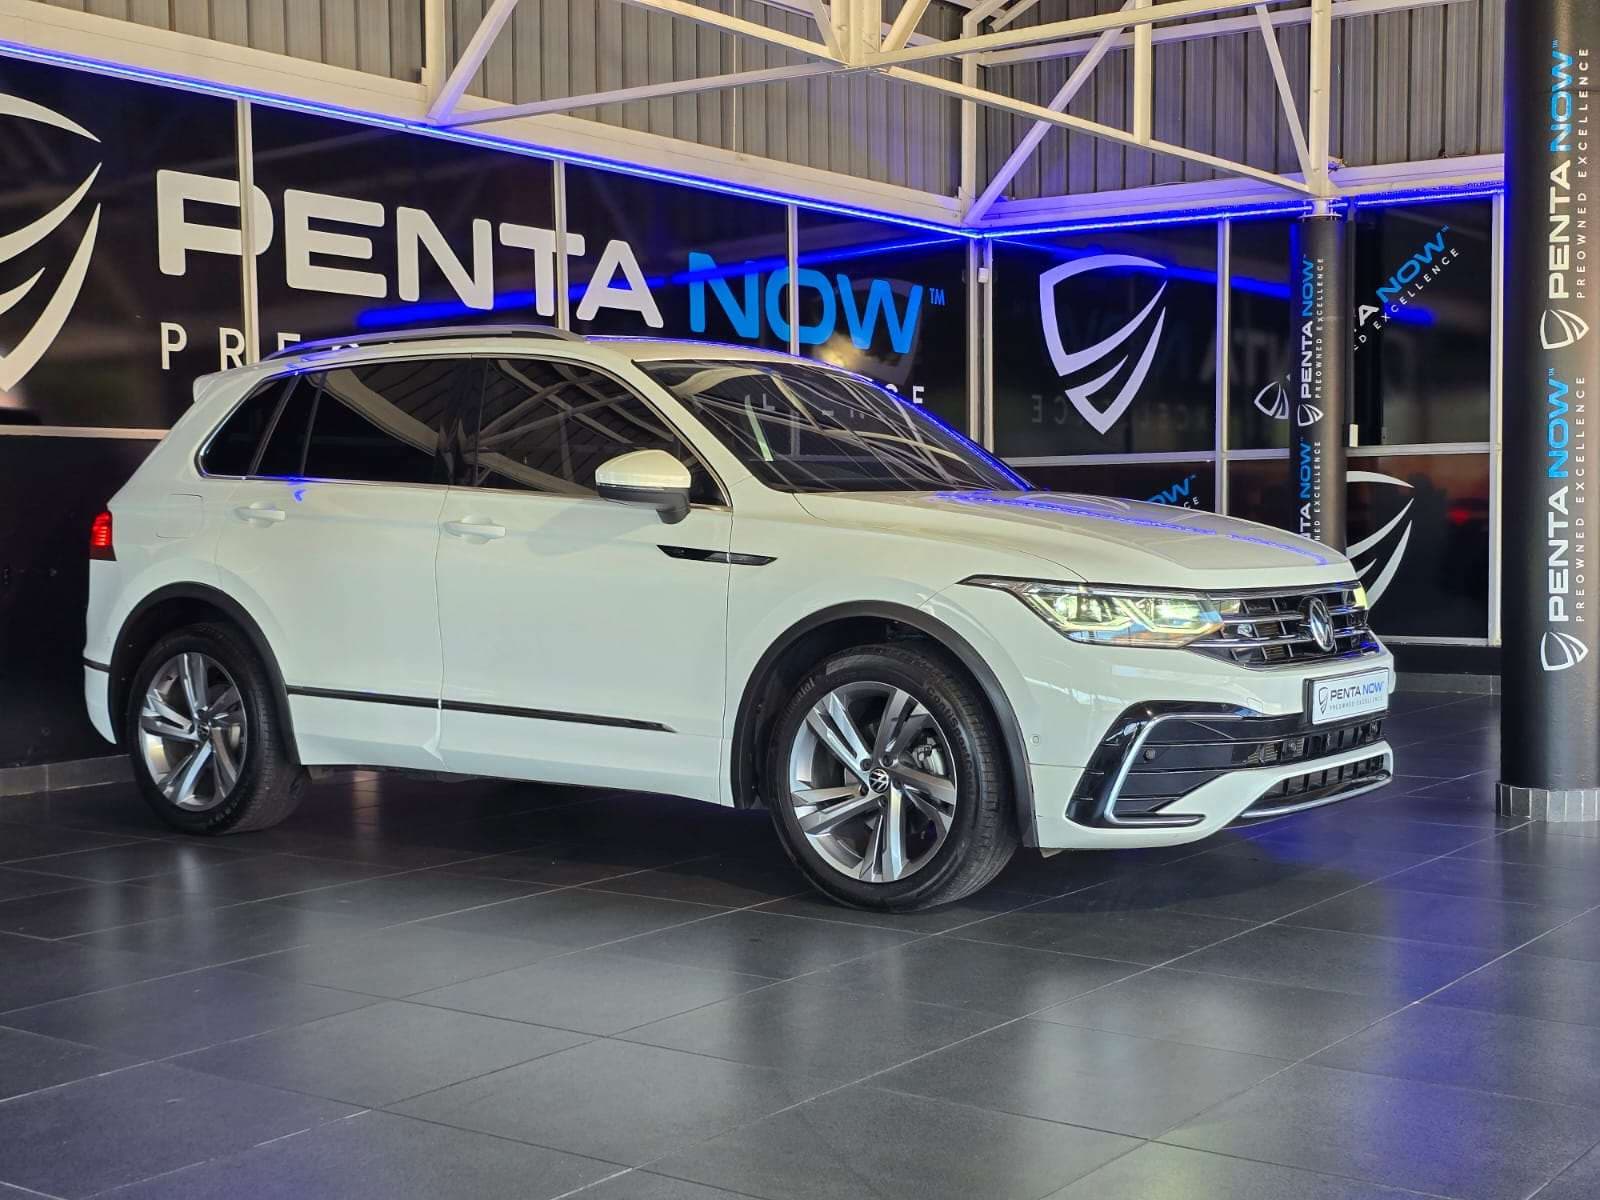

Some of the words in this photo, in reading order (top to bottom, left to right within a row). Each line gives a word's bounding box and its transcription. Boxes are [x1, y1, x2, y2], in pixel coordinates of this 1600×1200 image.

[1550, 49, 1574, 152] NOW
[1577, 48, 1589, 178] EXCELLENCE
[156, 169, 664, 328] PENTA
[688, 251, 923, 353] NOW
[1376, 232, 1445, 303] NOW
[1549, 159, 1572, 300] PENTA
[1576, 192, 1587, 299] PREOWNED
[1302, 259, 1314, 317] NOW
[1316, 258, 1324, 331] EXCELLENCE
[1373, 248, 1459, 330] EXCELLENCE
[1301, 320, 1313, 399] PENTA
[1314, 338, 1323, 399] PREOWNED
[1300, 442, 1312, 499] NOW
[1549, 377, 1569, 479] NOW
[1575, 377, 1585, 503] EXCELLENCE
[1548, 485, 1569, 622] PENTA
[1575, 517, 1585, 622] PREOWNED
[1330, 685, 1361, 701] PENTA
[1362, 682, 1383, 695] NOW
